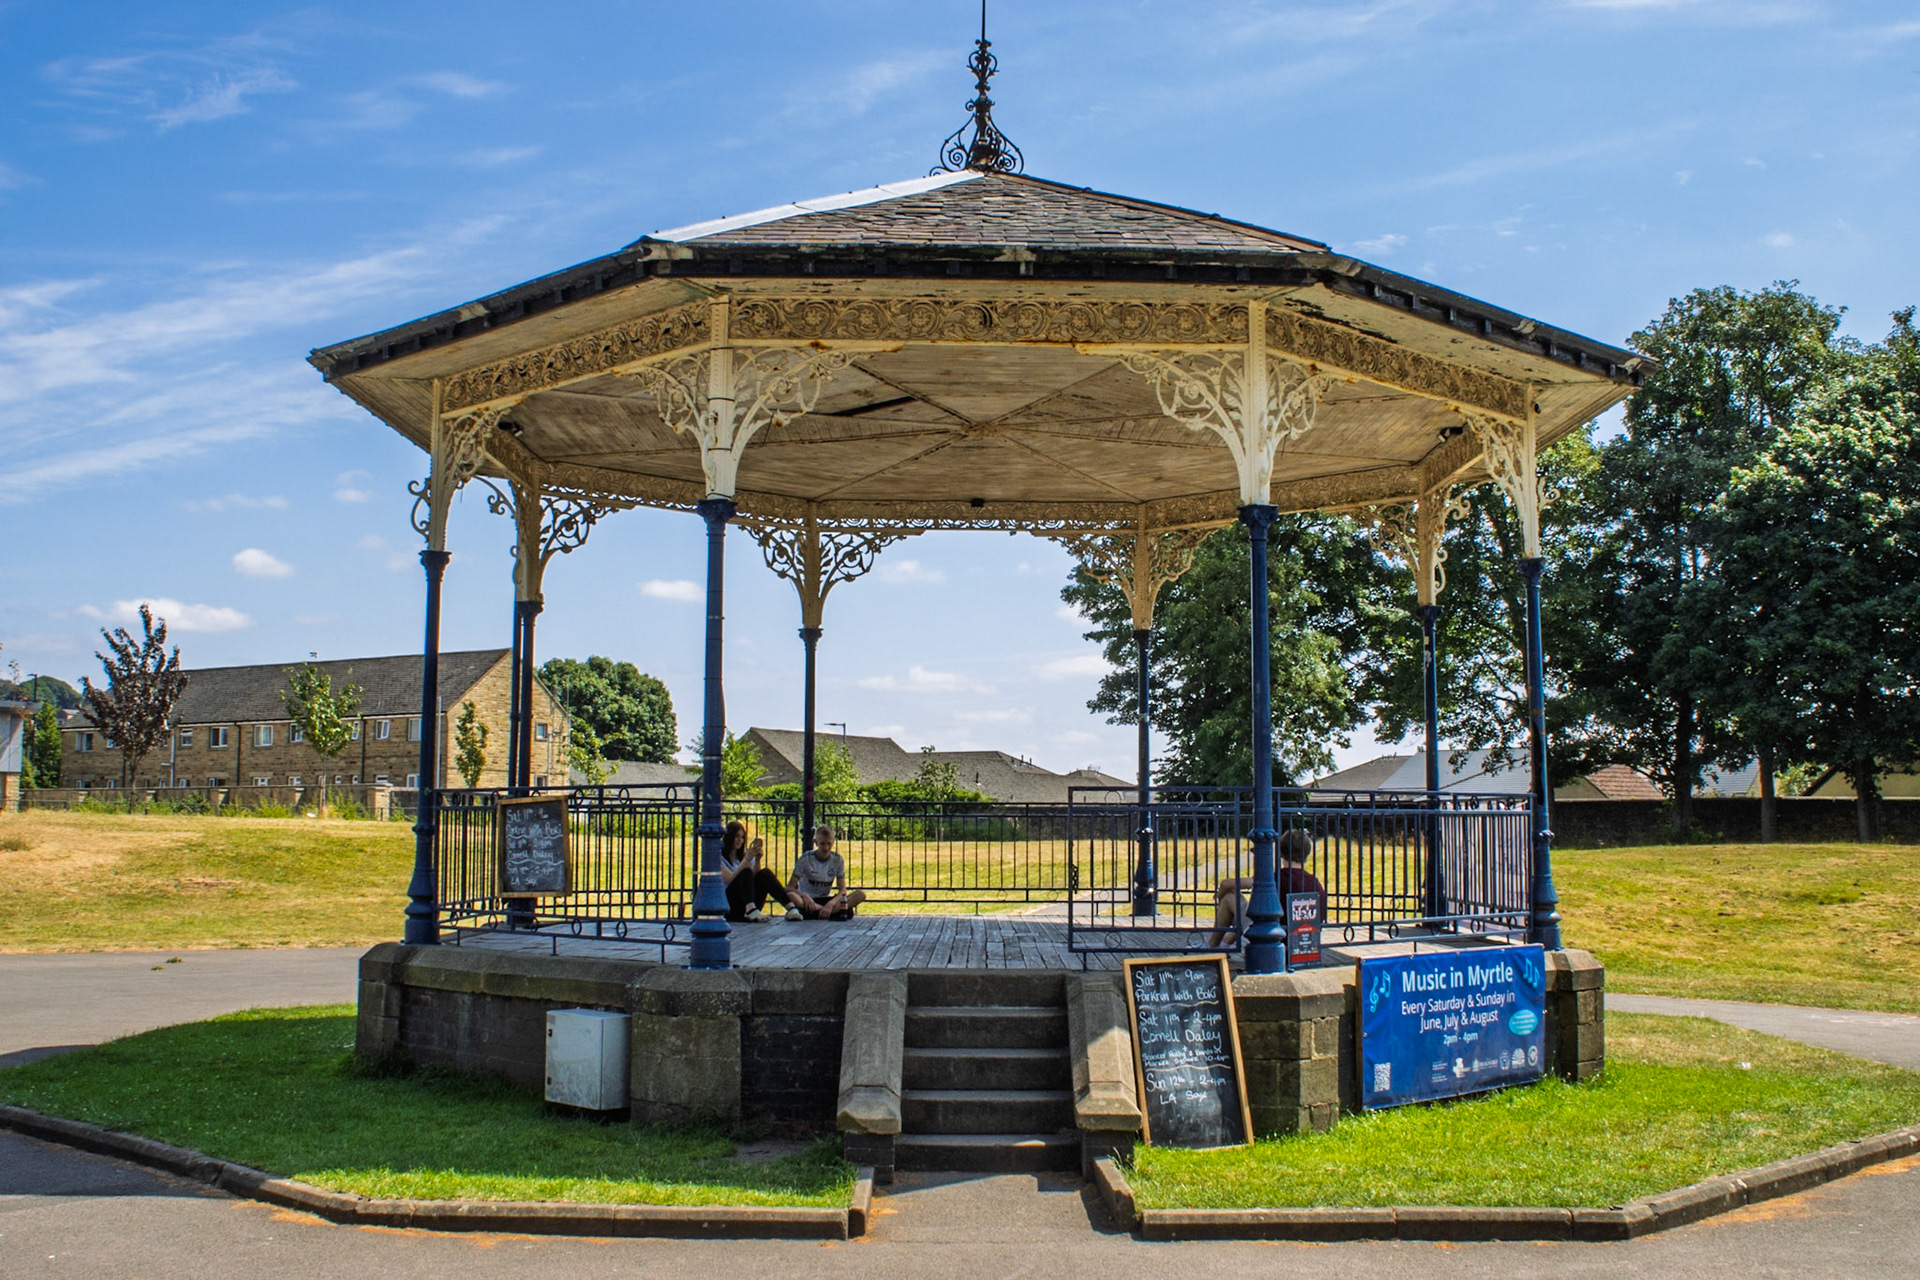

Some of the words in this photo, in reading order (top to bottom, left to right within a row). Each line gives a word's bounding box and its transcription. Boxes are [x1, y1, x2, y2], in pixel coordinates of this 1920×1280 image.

[1135, 970, 1155, 988] Sat
[1159, 972, 1173, 984] 11th
[1185, 969, 1204, 981] 9am
[1402, 968, 1447, 992] Music
[1450, 967, 1464, 988] in
[1468, 962, 1514, 991] Myrtle
[1174, 990, 1193, 1001] with
[1402, 1000, 1426, 1016] Every
[1428, 995, 1466, 1013] Saturday
[1468, 995, 1474, 1008] &
[1476, 991, 1505, 1007] Sunday
[1507, 992, 1515, 1003] in
[1139, 1011, 1159, 1026] Sat
[1165, 1013, 1180, 1026] 11th
[1193, 1011, 1222, 1026] 2-4pm
[1420, 1016, 1443, 1034] June,
[1444, 1013, 1459, 1031] July
[1461, 1013, 1468, 1026] &
[1470, 1009, 1498, 1027] August
[1185, 1030, 1222, 1050] Daley
[1443, 1035, 1457, 1046] 2pm
[1463, 1032, 1478, 1045] 4pm
[1146, 1073, 1166, 1092] Sun
[1159, 1094, 1177, 1105] LA
